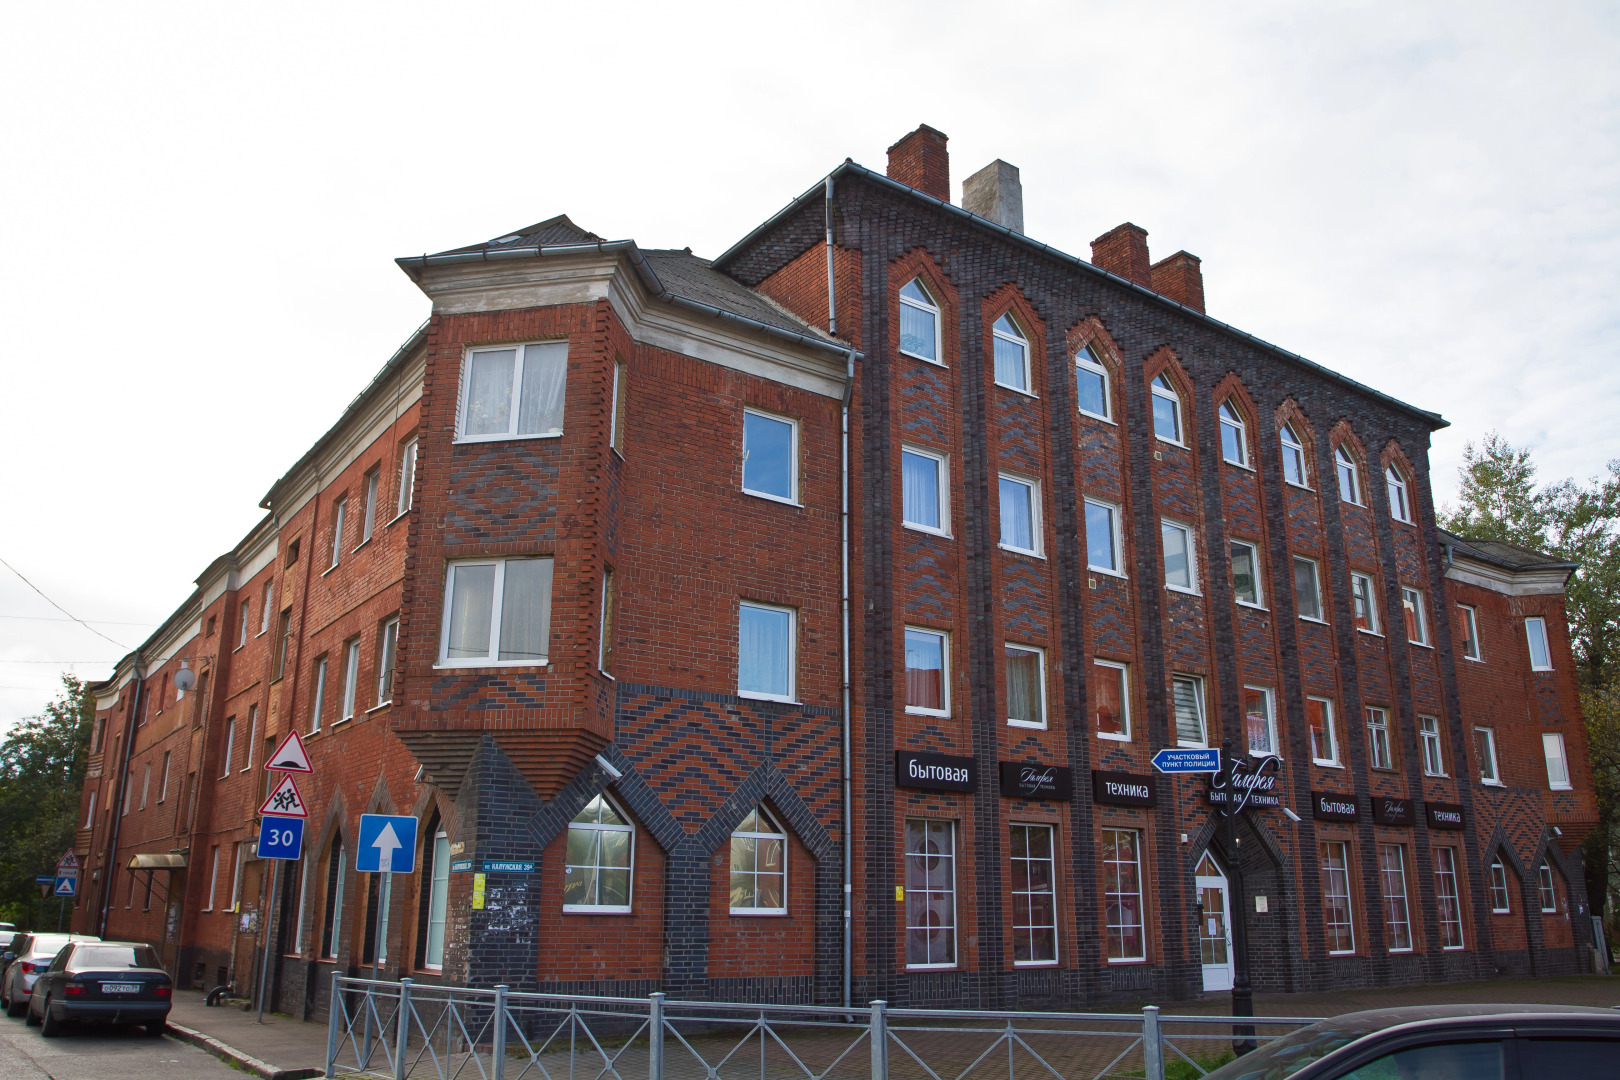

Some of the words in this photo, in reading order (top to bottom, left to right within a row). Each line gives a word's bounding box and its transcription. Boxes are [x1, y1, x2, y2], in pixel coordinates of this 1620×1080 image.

[1166, 753, 1210, 761] УЧАСТКОВЫЙ
[1184, 760, 1216, 768] ПОЛИЦИИ
[908, 759, 969, 783] бытовая
[1105, 782, 1149, 798] техника
[1210, 791, 1242, 803] БЫТАЯ
[1251, 795, 1279, 805] ТЕХНИКА
[1320, 797, 1355, 815] бытовая
[1433, 810, 1461, 823] техника
[267, 828, 294, 847] 30
